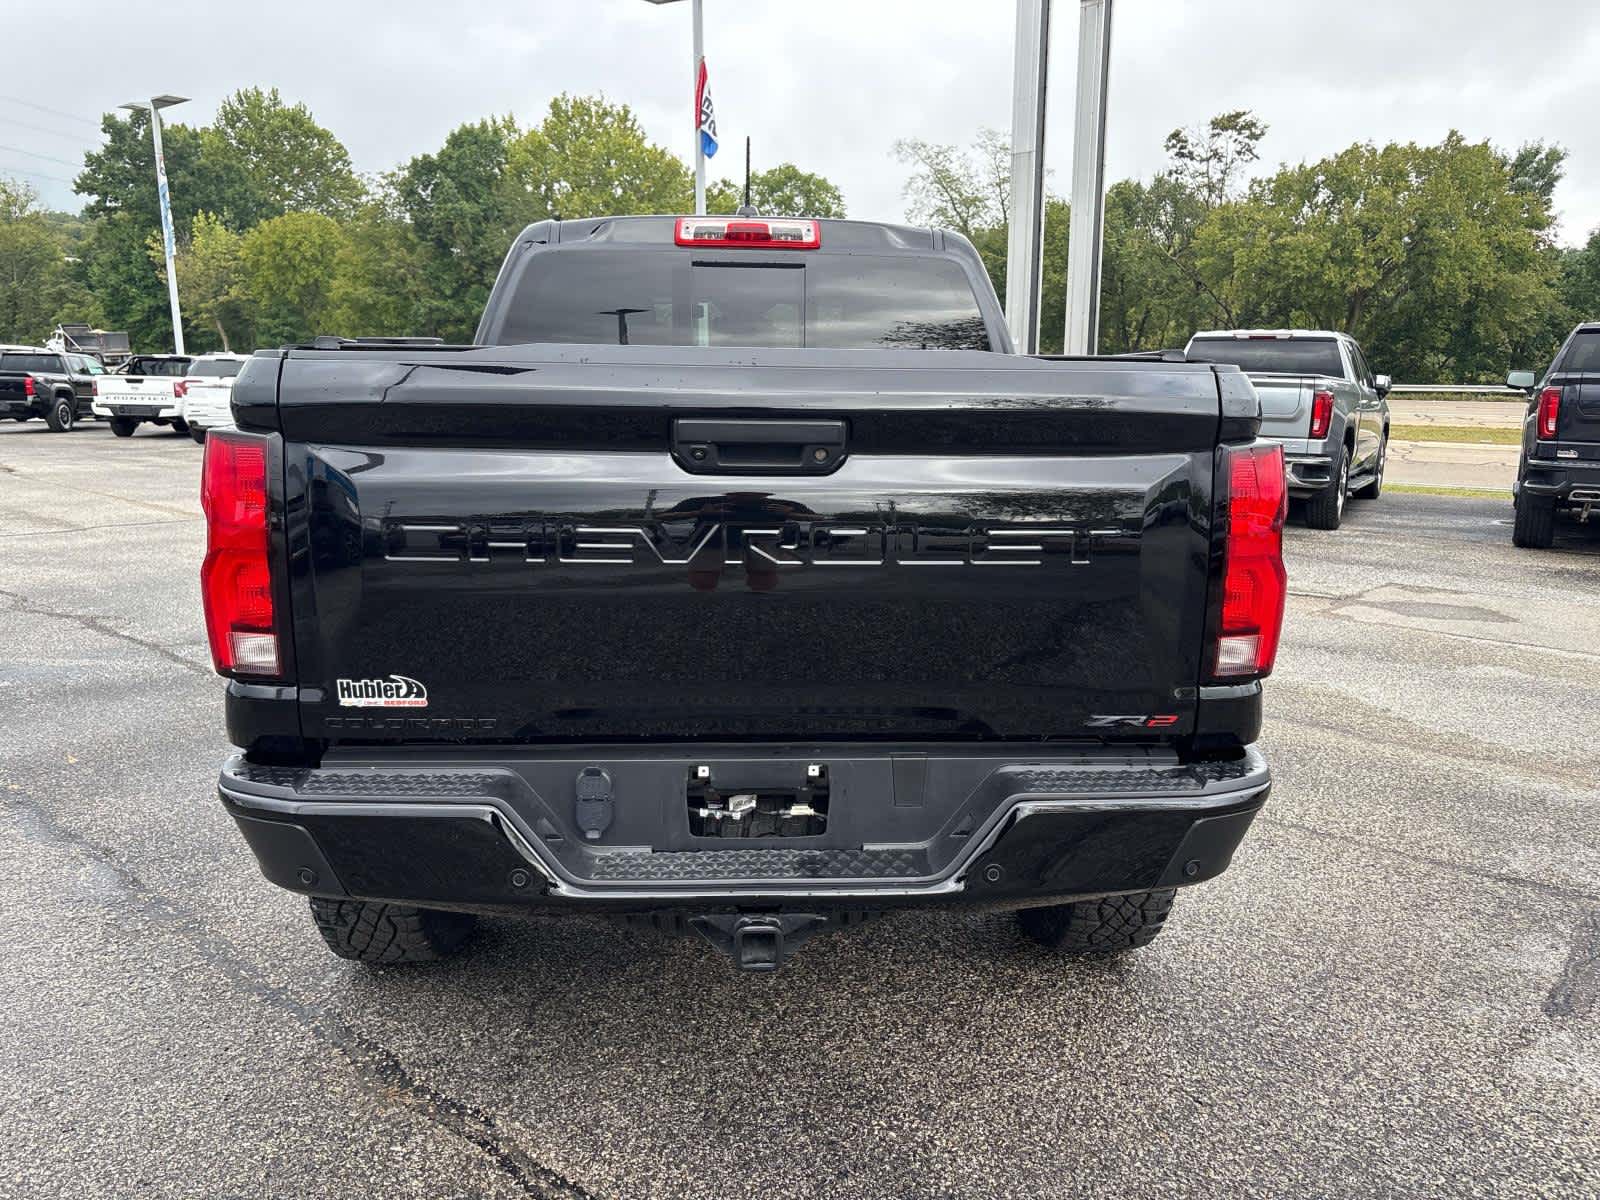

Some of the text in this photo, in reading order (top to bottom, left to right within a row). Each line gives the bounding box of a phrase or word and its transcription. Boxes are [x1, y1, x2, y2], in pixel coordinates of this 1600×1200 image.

[384, 522, 1122, 566] CHEVROLET
[338, 679, 403, 698] Hubler
[323, 717, 497, 729] COLORADO
[1086, 714, 1179, 728] ZR2
